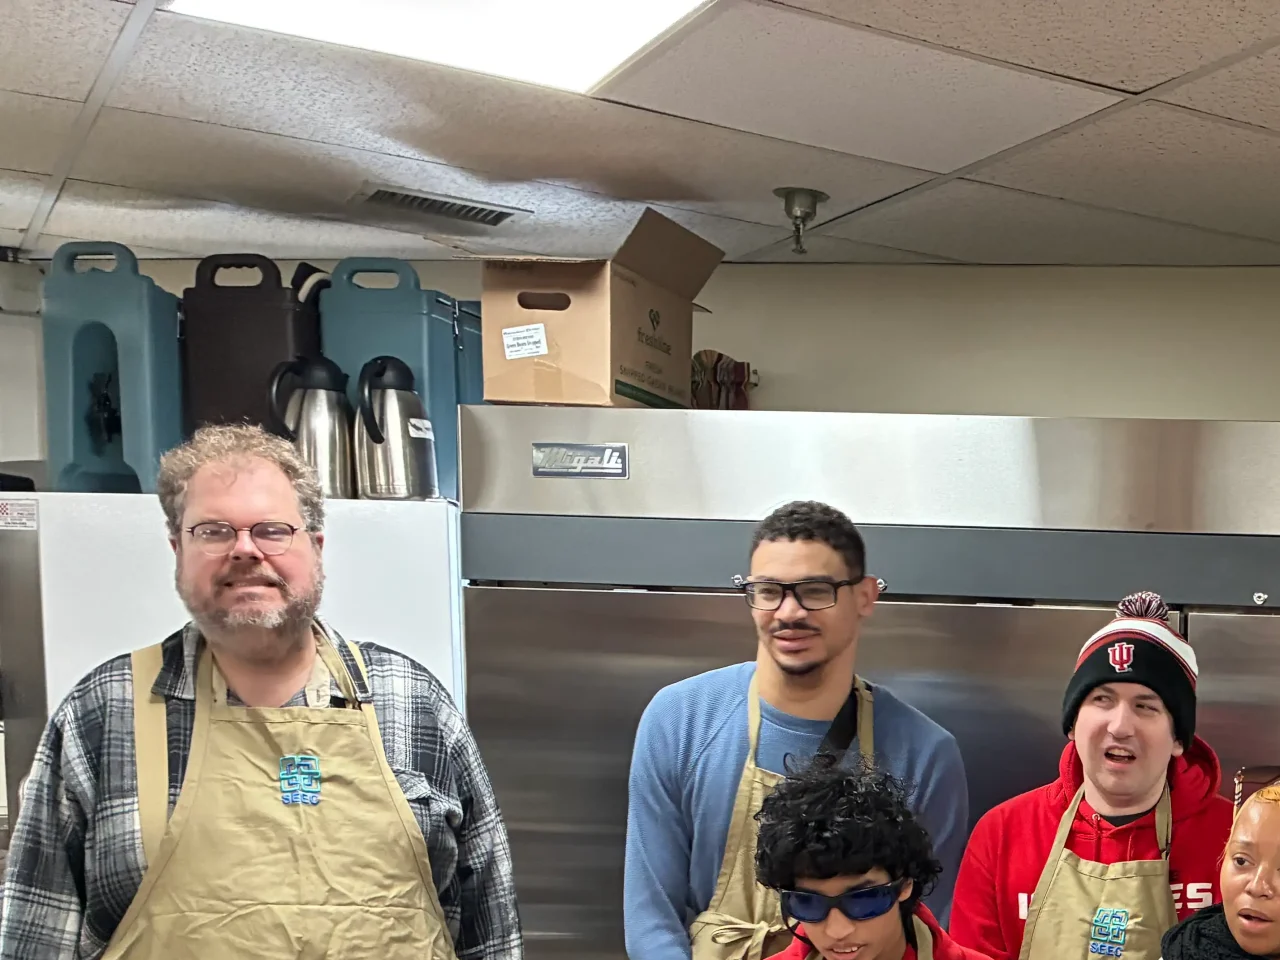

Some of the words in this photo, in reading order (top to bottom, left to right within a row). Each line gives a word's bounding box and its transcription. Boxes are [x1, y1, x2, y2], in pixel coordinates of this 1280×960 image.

[538, 447, 622, 472] Migali
[281, 792, 320, 806] SEEC
[1090, 942, 1122, 958] SEEC
